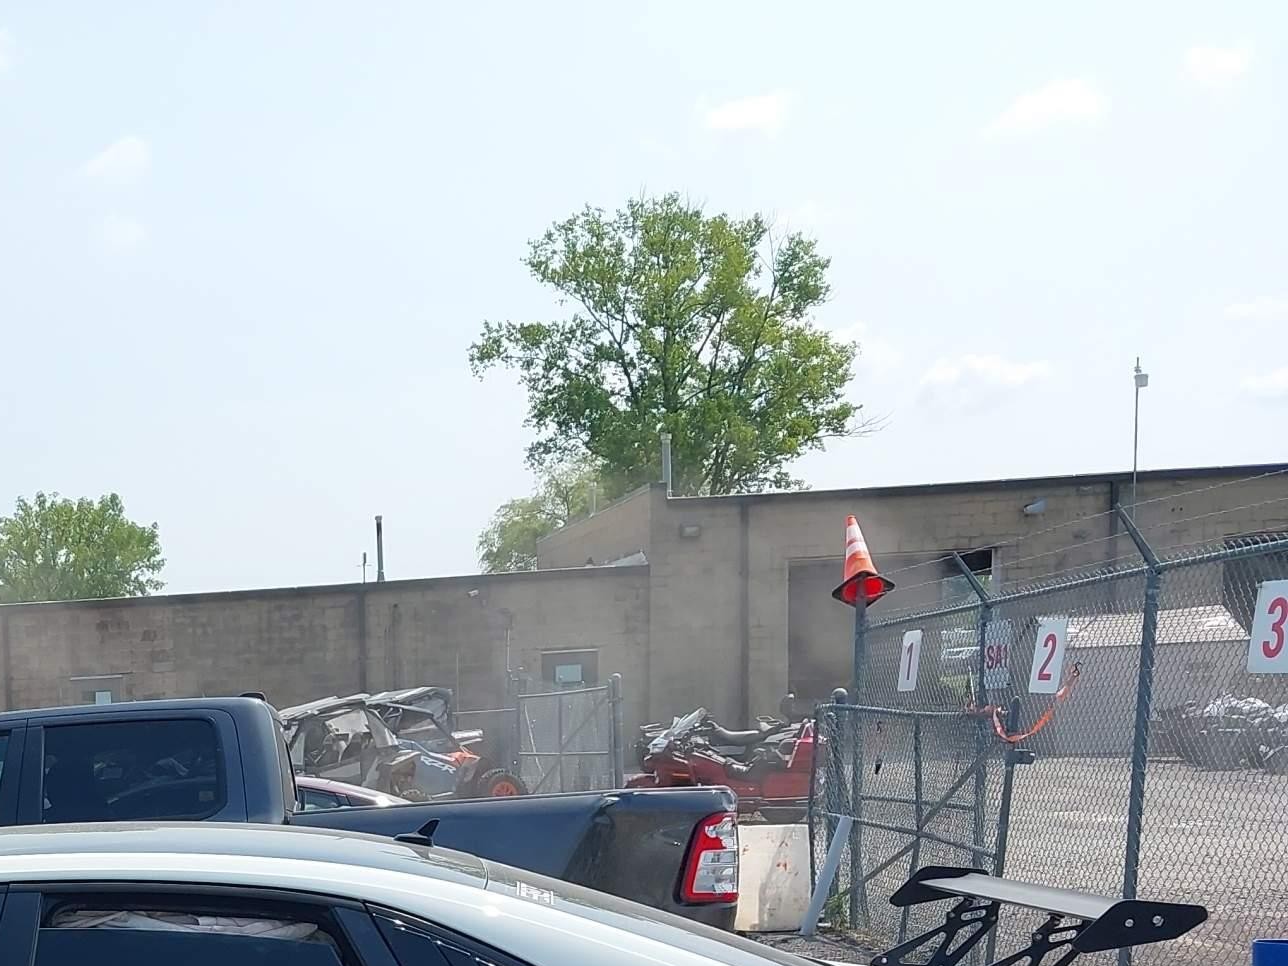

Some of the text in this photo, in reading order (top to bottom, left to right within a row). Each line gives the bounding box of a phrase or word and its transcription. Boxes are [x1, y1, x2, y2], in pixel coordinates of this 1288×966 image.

[1263, 596, 1288, 659] 3
[906, 641, 914, 681] 1
[1037, 633, 1058, 681] 2
